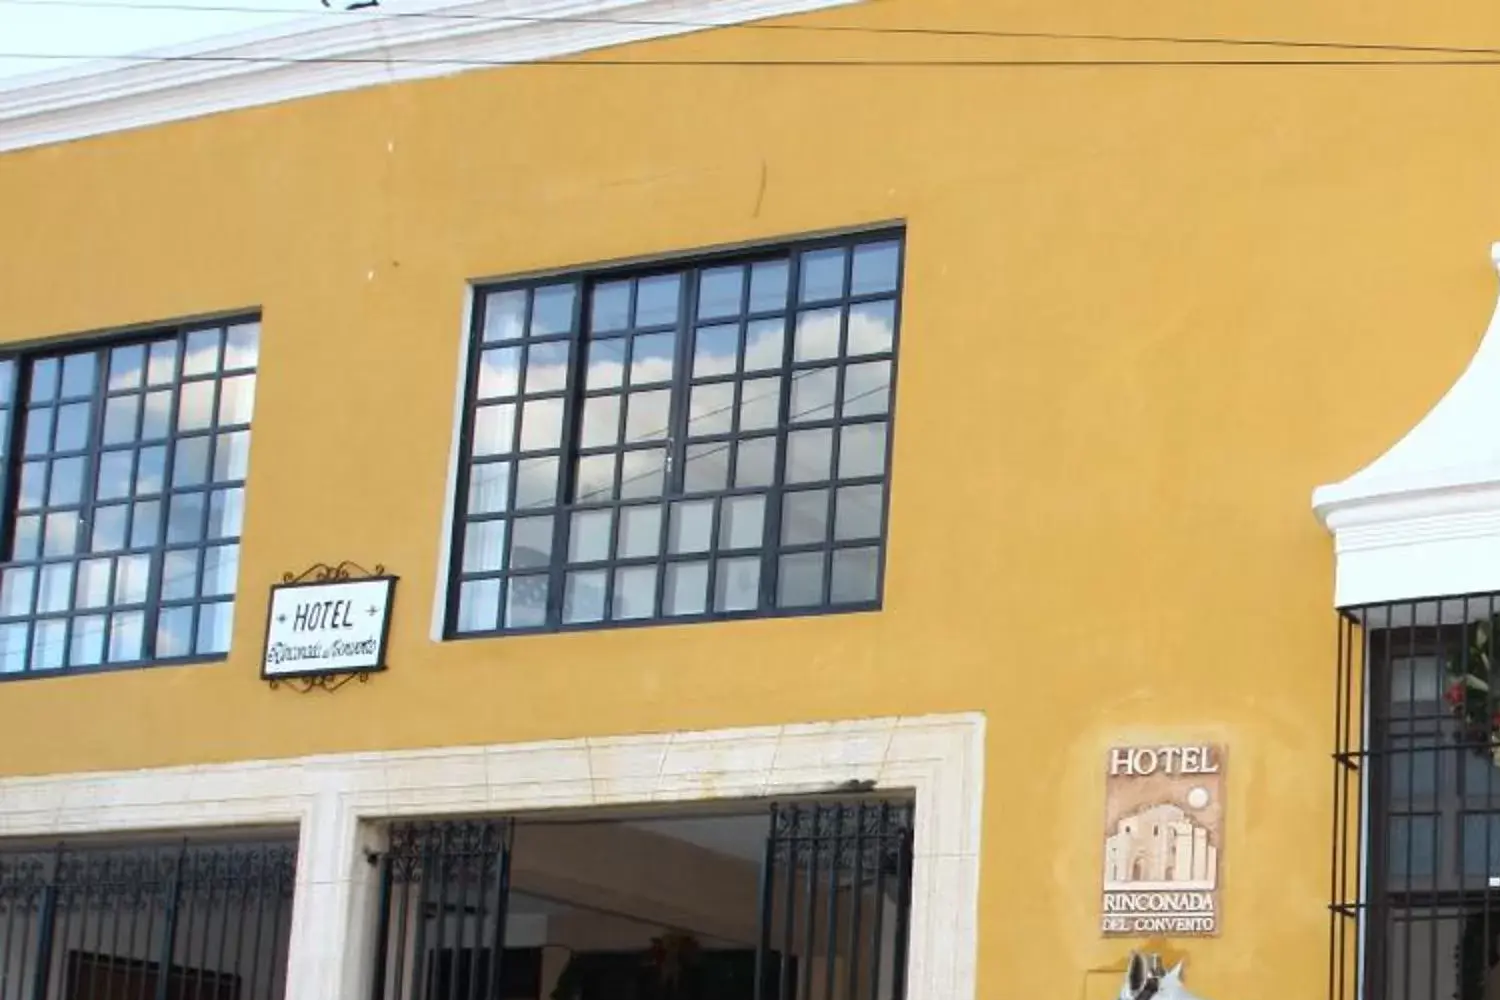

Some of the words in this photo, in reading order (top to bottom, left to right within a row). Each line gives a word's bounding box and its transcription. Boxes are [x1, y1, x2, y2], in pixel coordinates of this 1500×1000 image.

[293, 599, 353, 631] HOTEL
[1110, 747, 1219, 775] HOTEL
[1103, 893, 1213, 911] RINCONADA
[1103, 918, 1129, 931] DEL
[1134, 917, 1213, 931] CONVENTO
